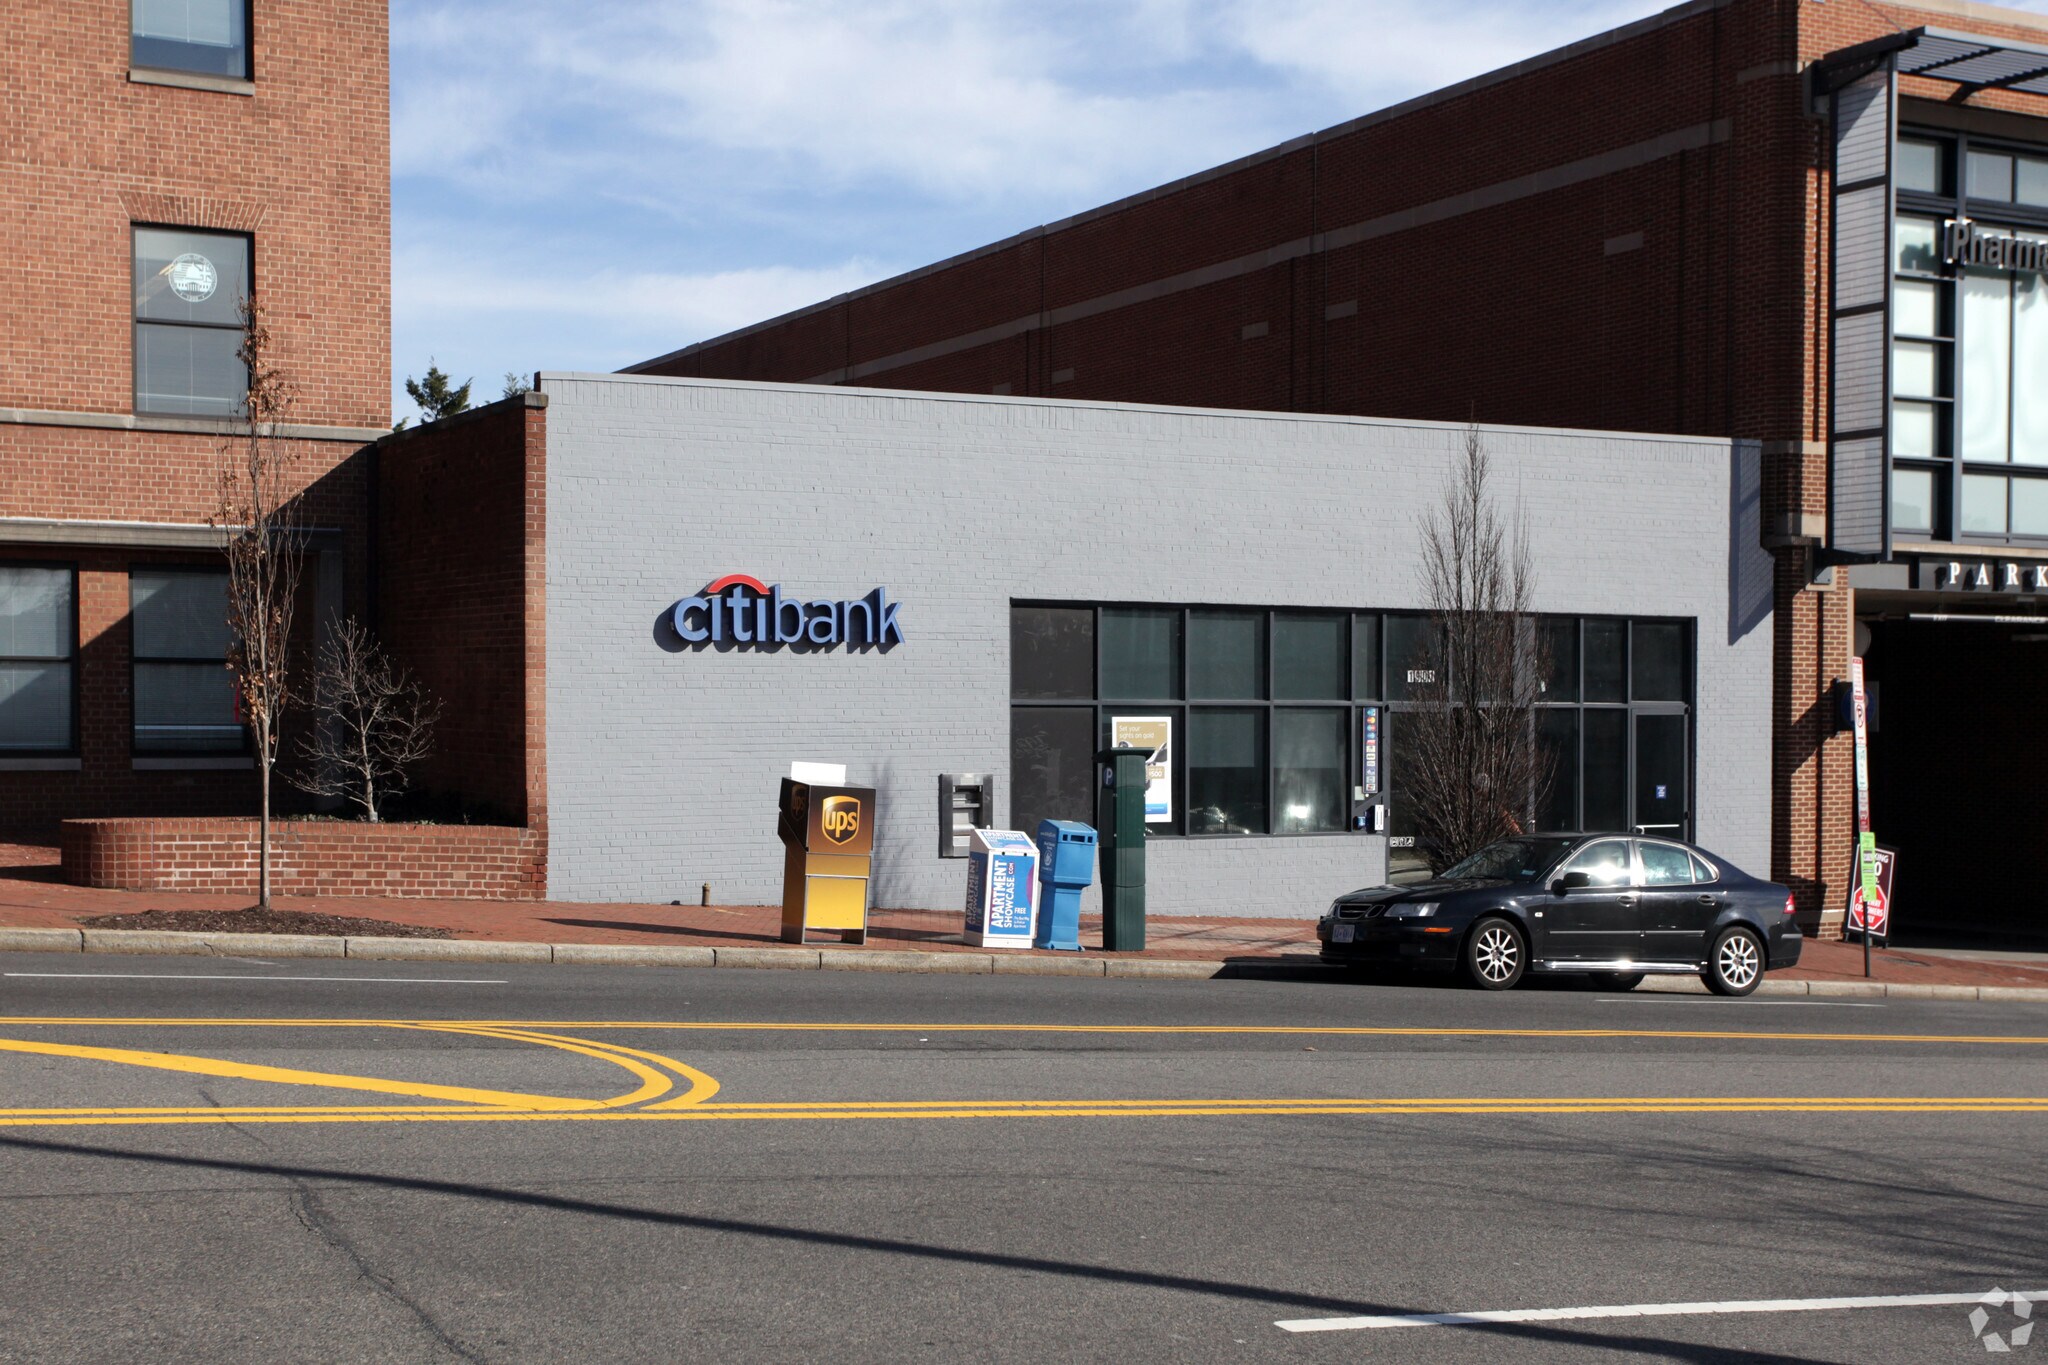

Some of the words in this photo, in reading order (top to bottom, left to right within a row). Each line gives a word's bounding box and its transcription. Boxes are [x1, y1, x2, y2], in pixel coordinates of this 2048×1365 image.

[673, 580, 905, 644] citibank
[825, 811, 857, 838] ups
[967, 859, 976, 923] APARTMENT
[991, 860, 1007, 928] APARTMENT
[1003, 877, 1015, 928] SHOWCASE
[1014, 907, 1026, 915] FREE
